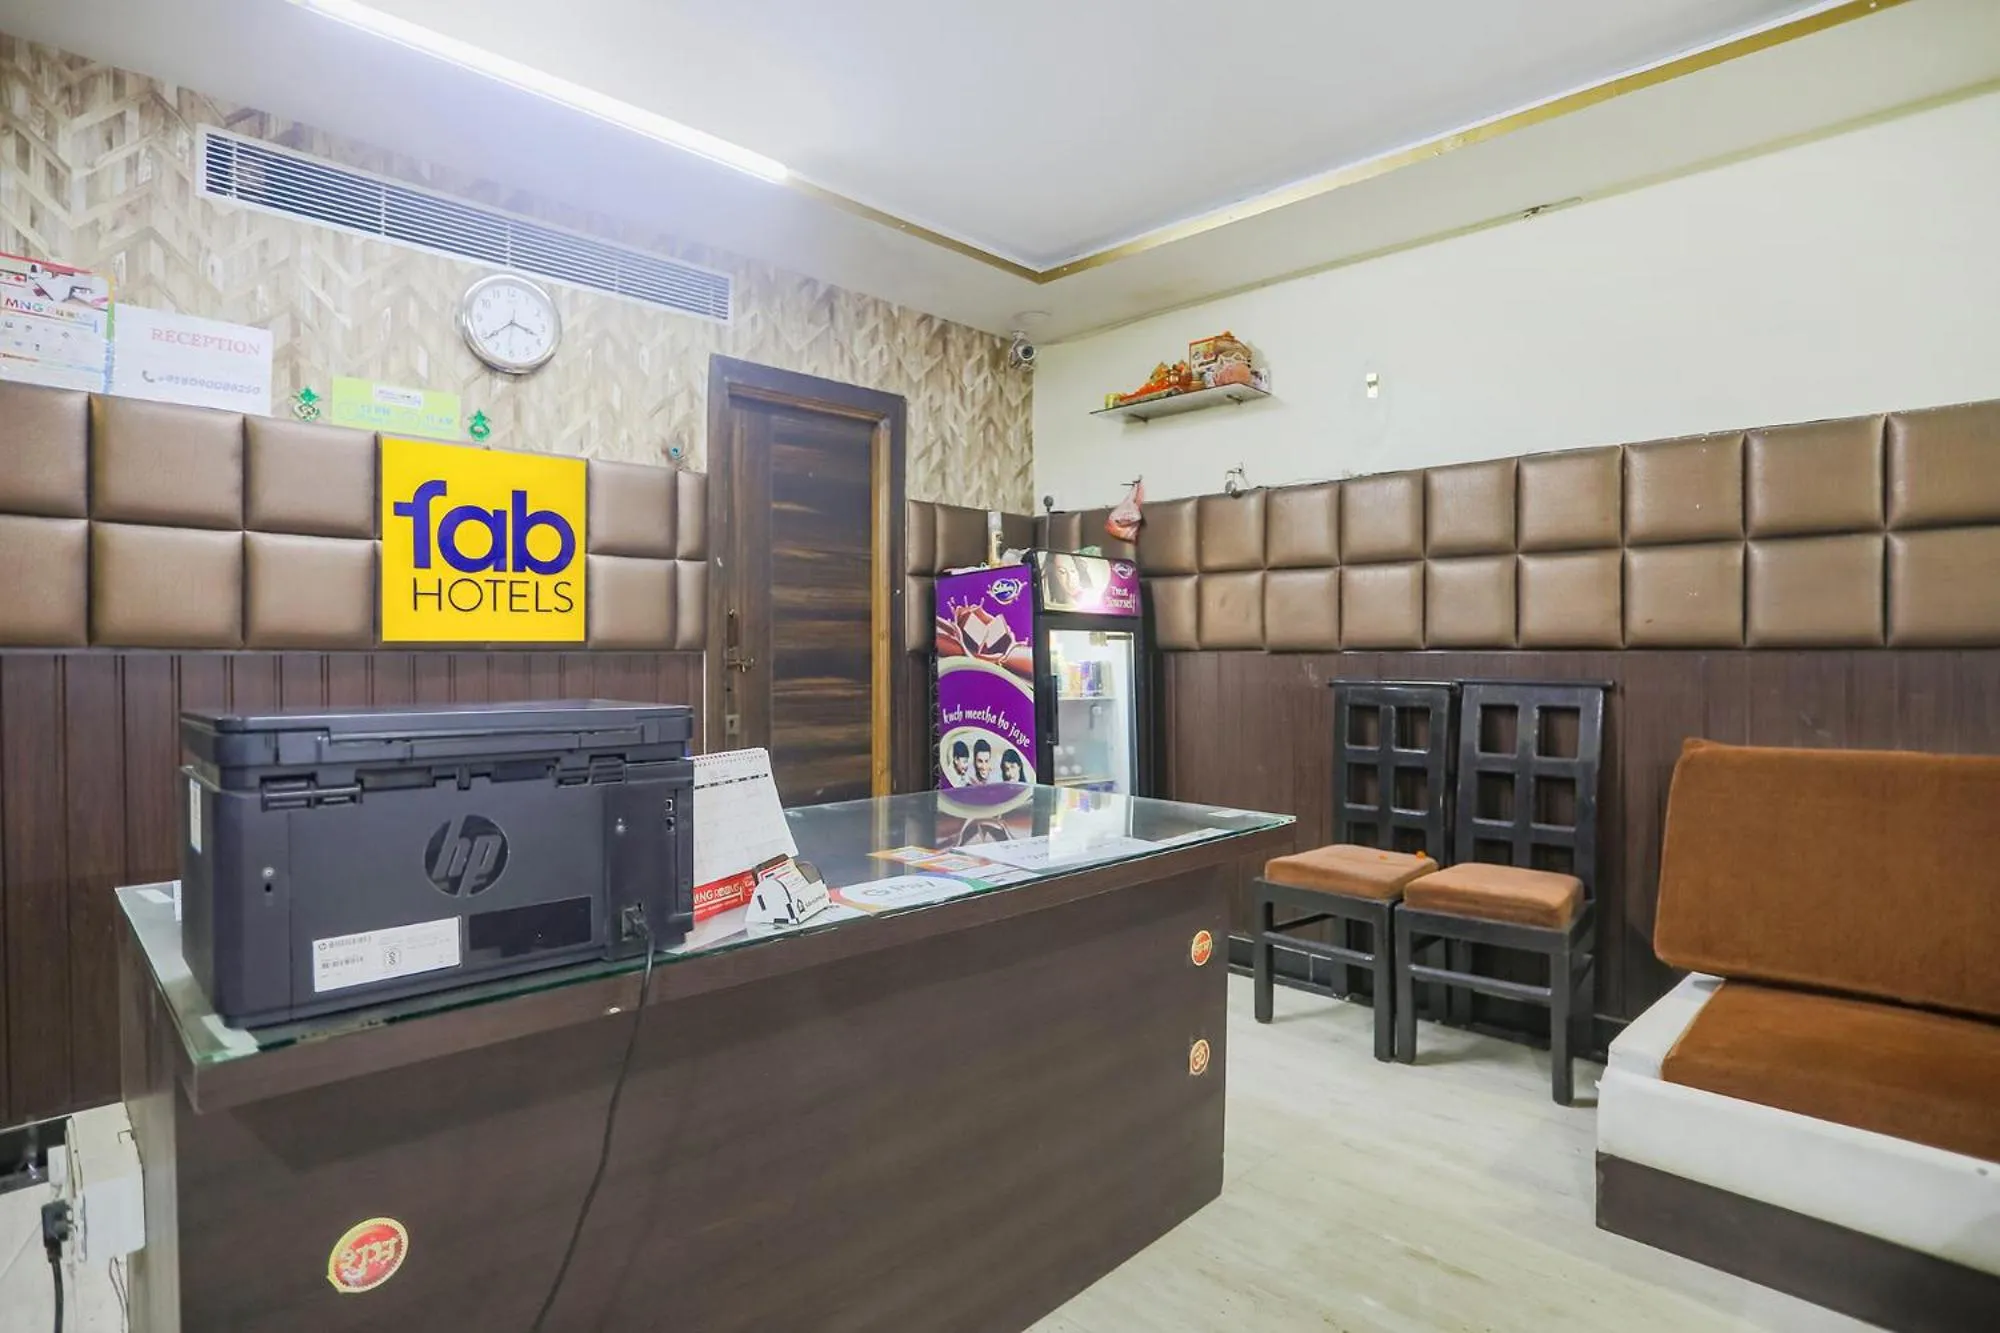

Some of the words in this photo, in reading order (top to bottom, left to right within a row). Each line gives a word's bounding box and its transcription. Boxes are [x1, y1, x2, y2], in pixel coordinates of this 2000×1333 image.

[5, 297, 44, 313] MNG
[151, 328, 260, 356] RECEPTION
[393, 480, 576, 575] fab
[413, 577, 574, 613] HOTELS
[965, 706, 997, 724] meetha
[1009, 723, 1030, 748] jaye
[431, 815, 502, 897] hp
